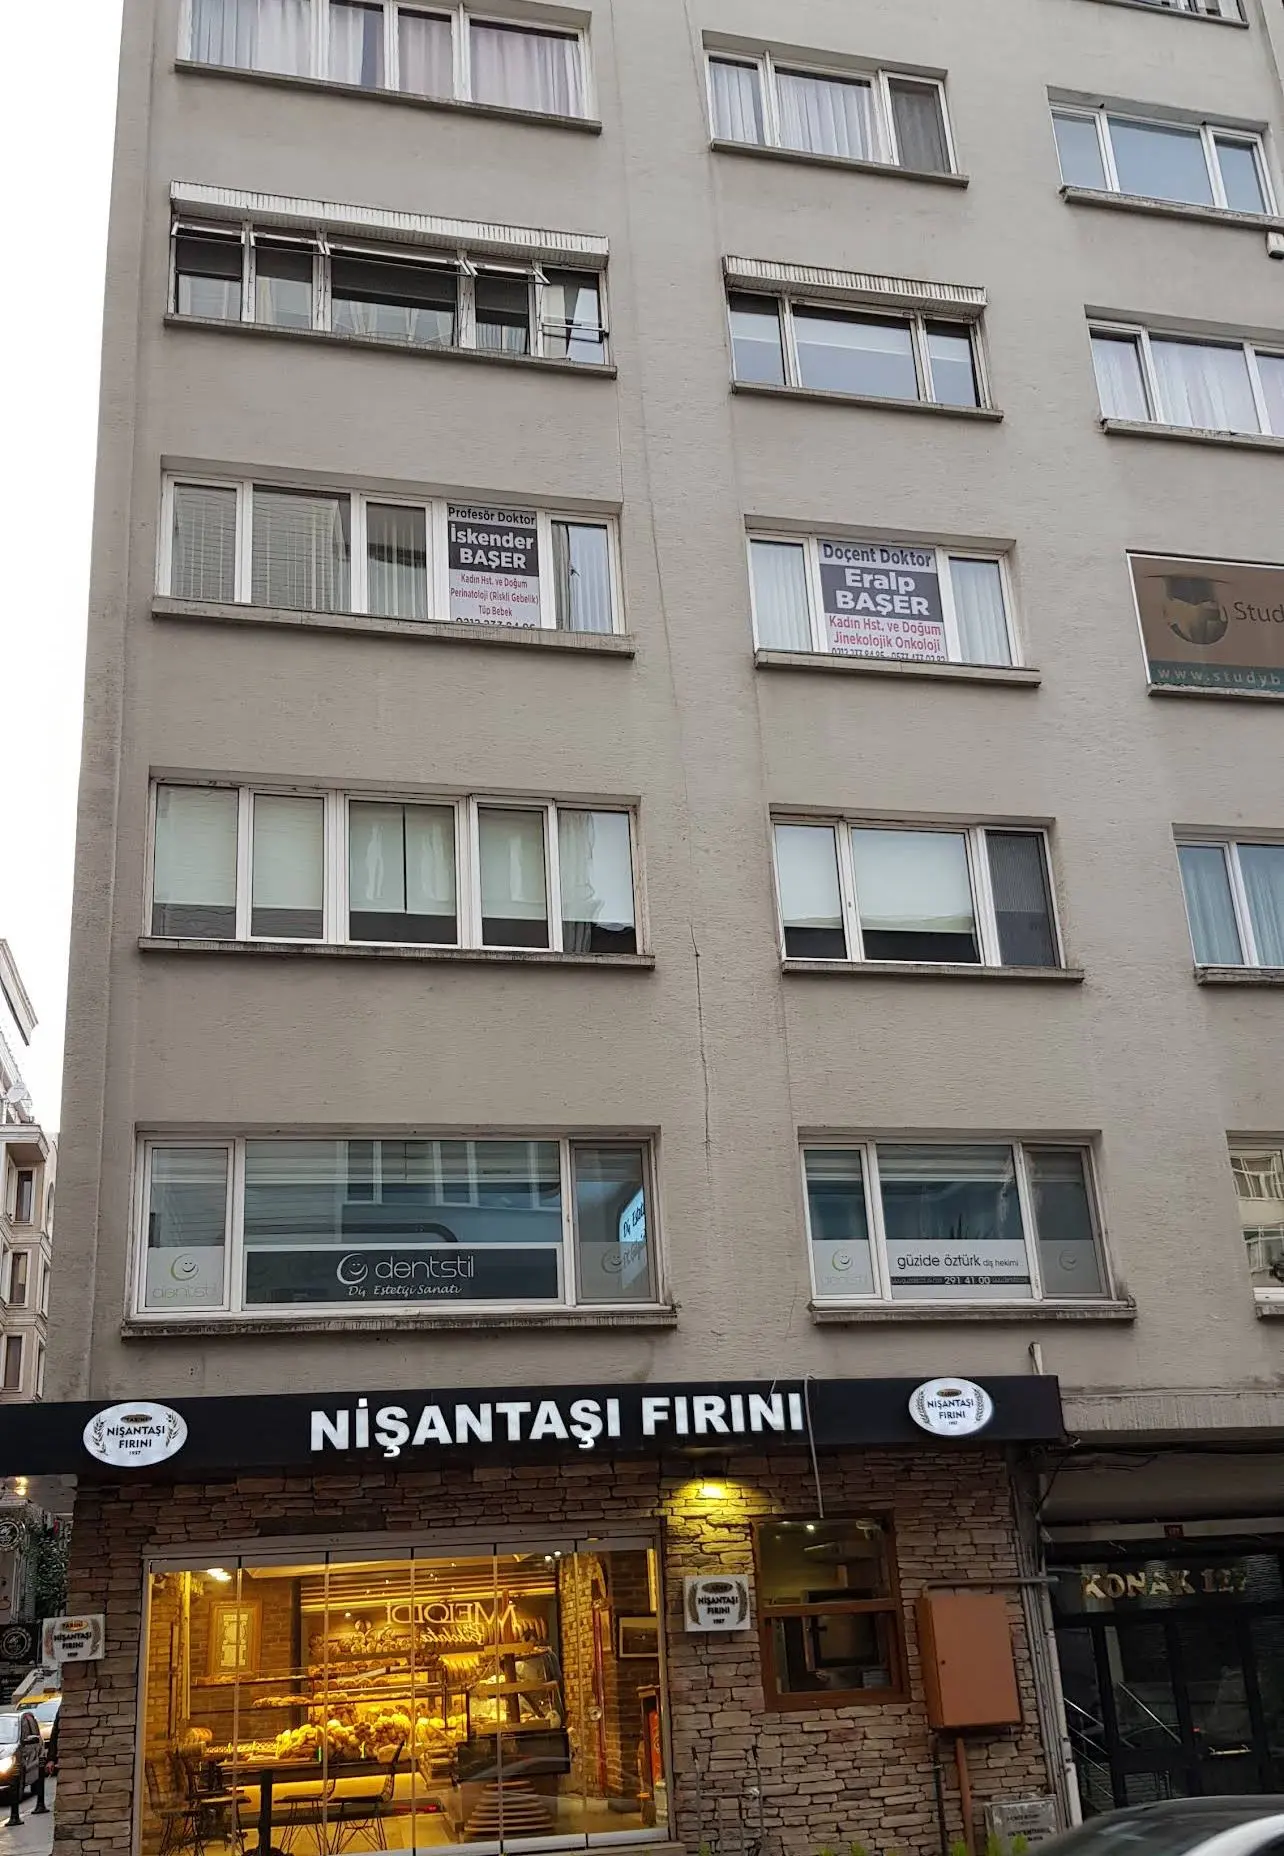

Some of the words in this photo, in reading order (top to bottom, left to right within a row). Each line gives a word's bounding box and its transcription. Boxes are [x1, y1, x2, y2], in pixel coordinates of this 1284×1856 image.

[448, 507, 495, 521] Profesör
[498, 511, 535, 525] Doktor
[451, 523, 534, 550] İskender
[460, 548, 526, 569] BAŞER
[823, 543, 876, 563] Doçent
[880, 549, 931, 567] Doktor
[461, 573, 479, 584] Kadın
[481, 574, 494, 585] Hst.
[495, 578, 503, 586] ve
[504, 576, 528, 589] Doğum
[844, 568, 915, 594] Eralp
[450, 588, 488, 601] Perinatoloji
[479, 605, 491, 616] Tüp
[492, 606, 513, 617] Bebek
[835, 590, 930, 616] BAŞER
[829, 615, 861, 629] Kadın
[863, 619, 884, 632] Hst.
[887, 623, 900, 632] ve
[903, 621, 941, 637] Doğum
[834, 631, 892, 649] Jinekolojik
[895, 636, 941, 653] Onkoloji
[375, 1255, 474, 1279] dentstil
[897, 1253, 940, 1269] güzide
[944, 1253, 981, 1267] öztürk
[944, 1276, 960, 1285] 291
[964, 1276, 975, 1285] 41
[978, 1276, 991, 1285] 00
[927, 1398, 974, 1410] NİŞANTAŞI
[939, 1410, 966, 1420] FIRINI
[106, 1424, 165, 1438] NİŞANTAŞI
[310, 1397, 620, 1458] NİŞANTAŞI
[641, 1391, 804, 1437] FIRINI
[119, 1439, 152, 1449] FIRINI
[1083, 1569, 1196, 1599] KONAK
[698, 1595, 738, 1606] NİŞANTAŞI
[707, 1606, 730, 1615] FIRINI
[54, 1632, 92, 1642] NİŞANTAŞI
